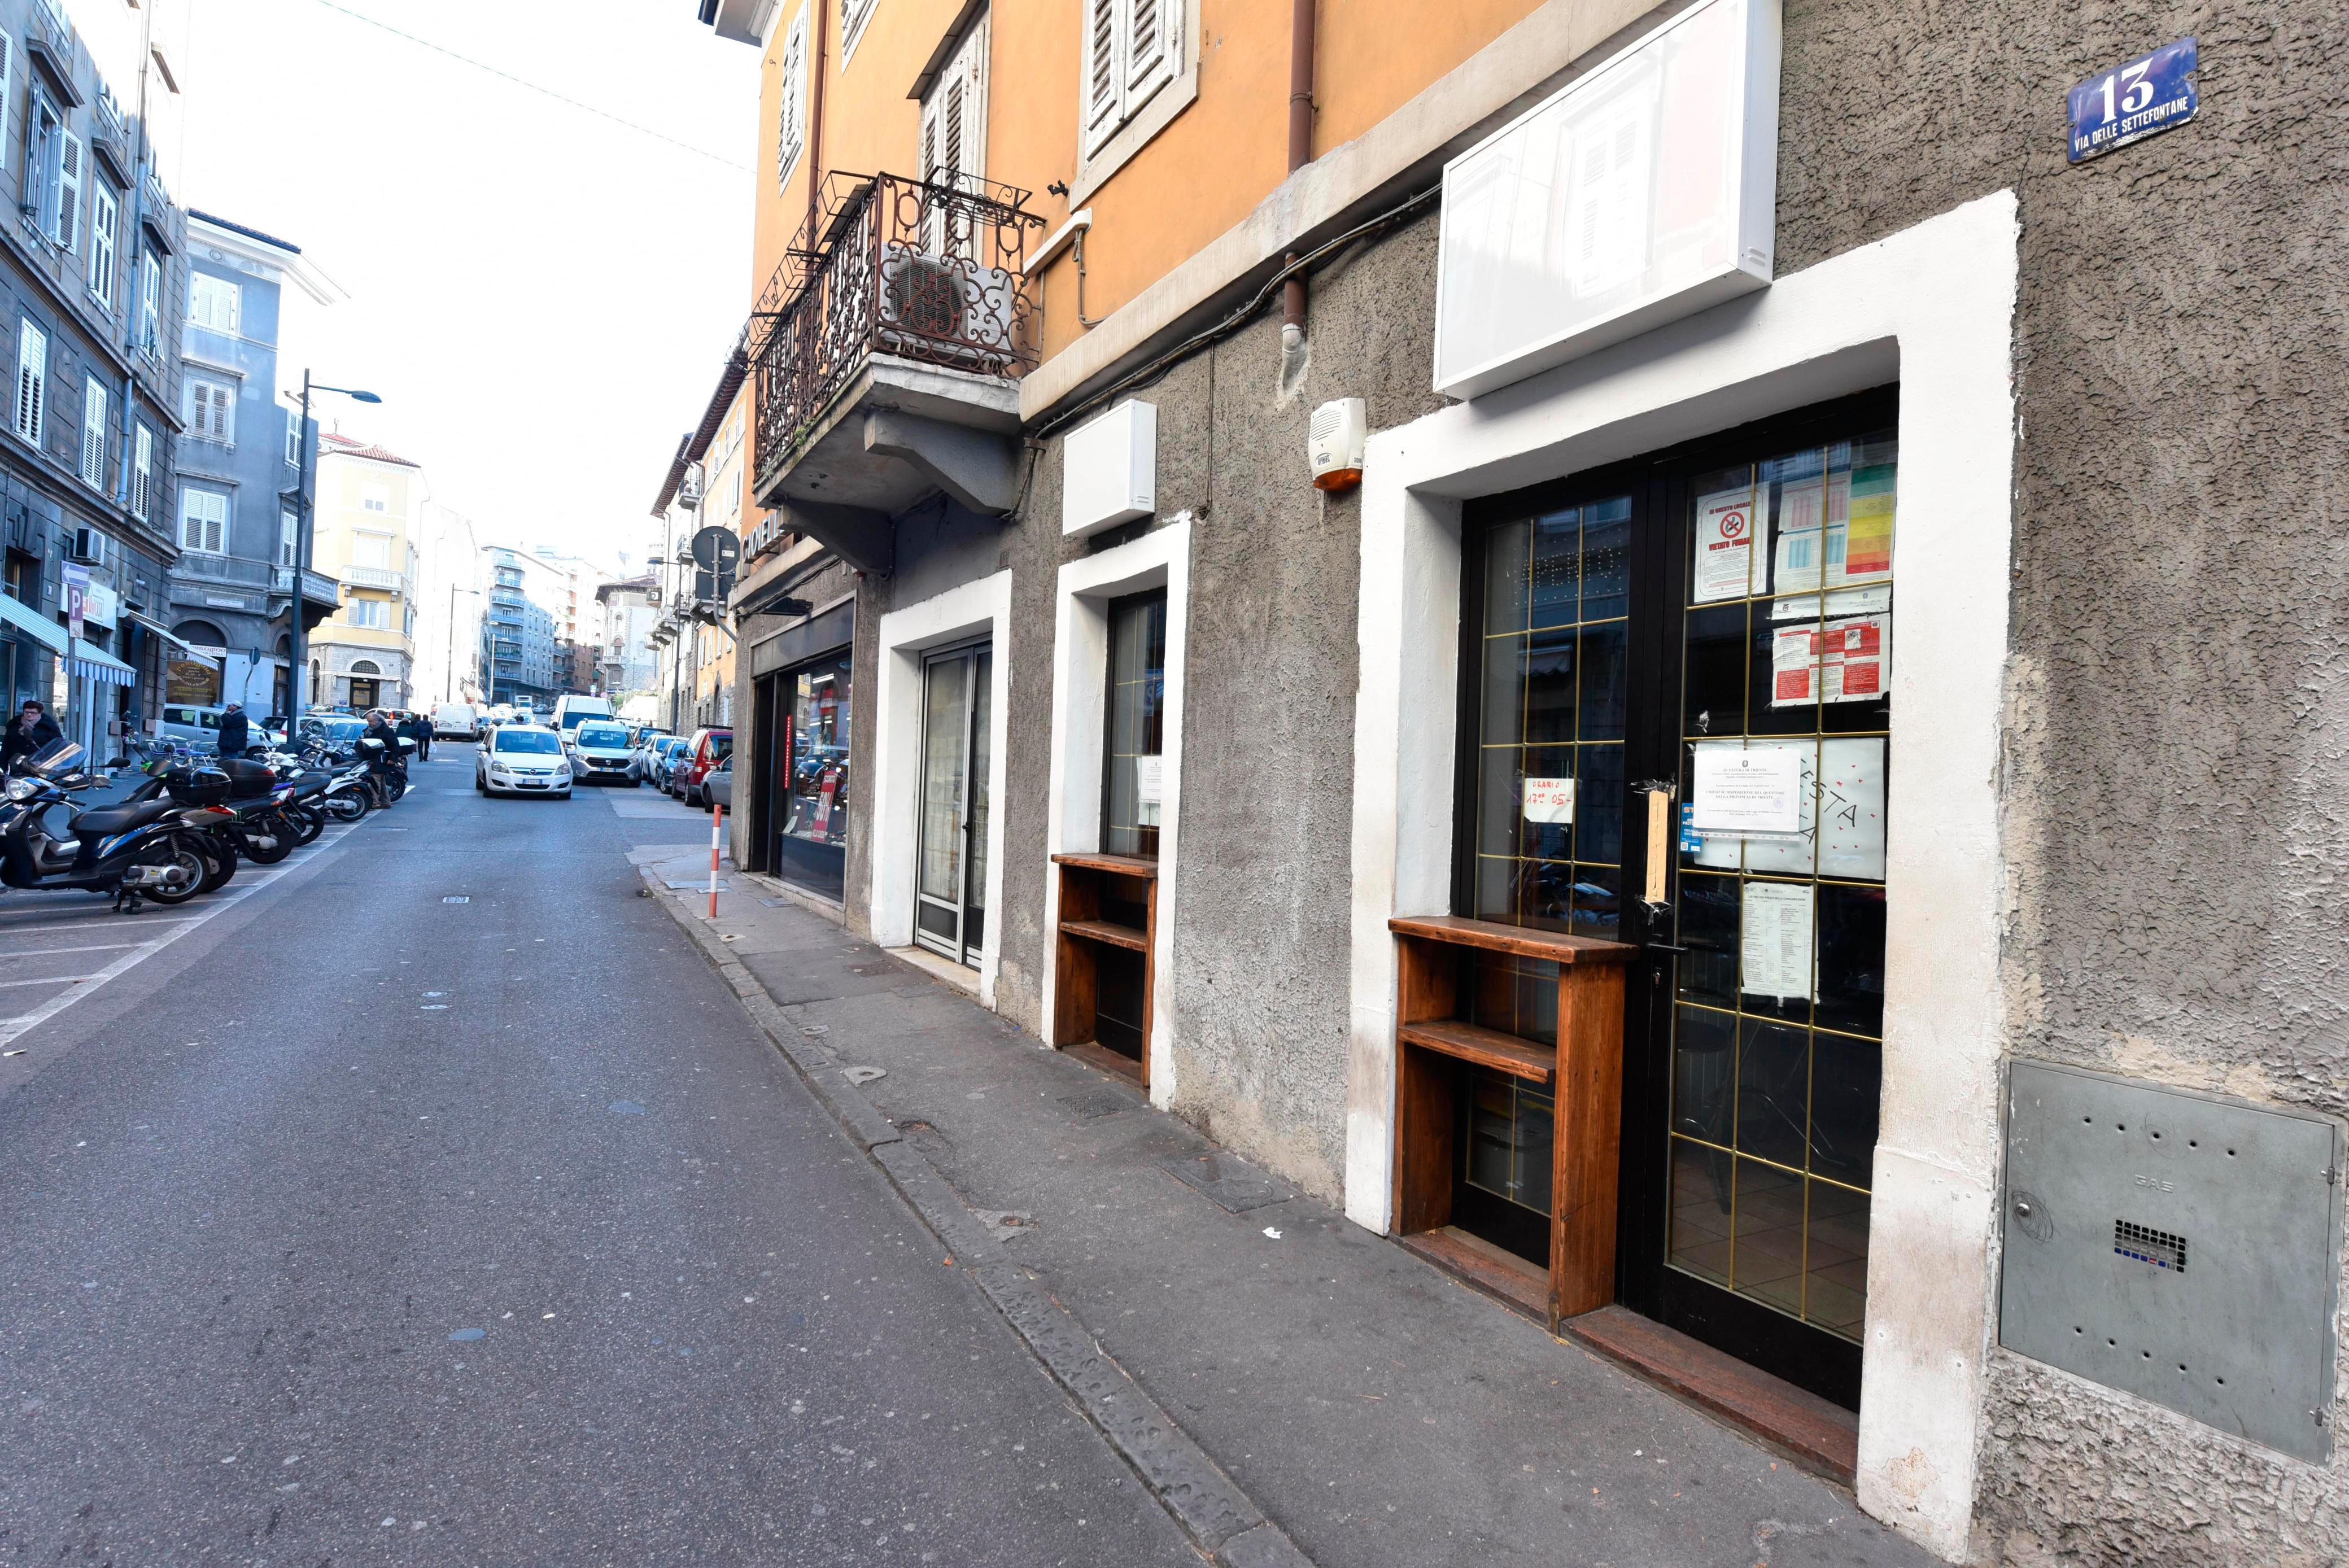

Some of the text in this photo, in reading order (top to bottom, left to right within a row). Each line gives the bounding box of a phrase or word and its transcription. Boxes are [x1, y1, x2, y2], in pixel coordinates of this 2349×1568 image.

[2099, 58, 2154, 124] 13
[2075, 96, 2188, 151] VIA DELLE SETTEFONTANE
[742, 509, 785, 563] GIOIELL
[1732, 537, 1750, 547] FUMAR
[72, 590, 81, 617] P
[2134, 1174, 2173, 1194] GAS
